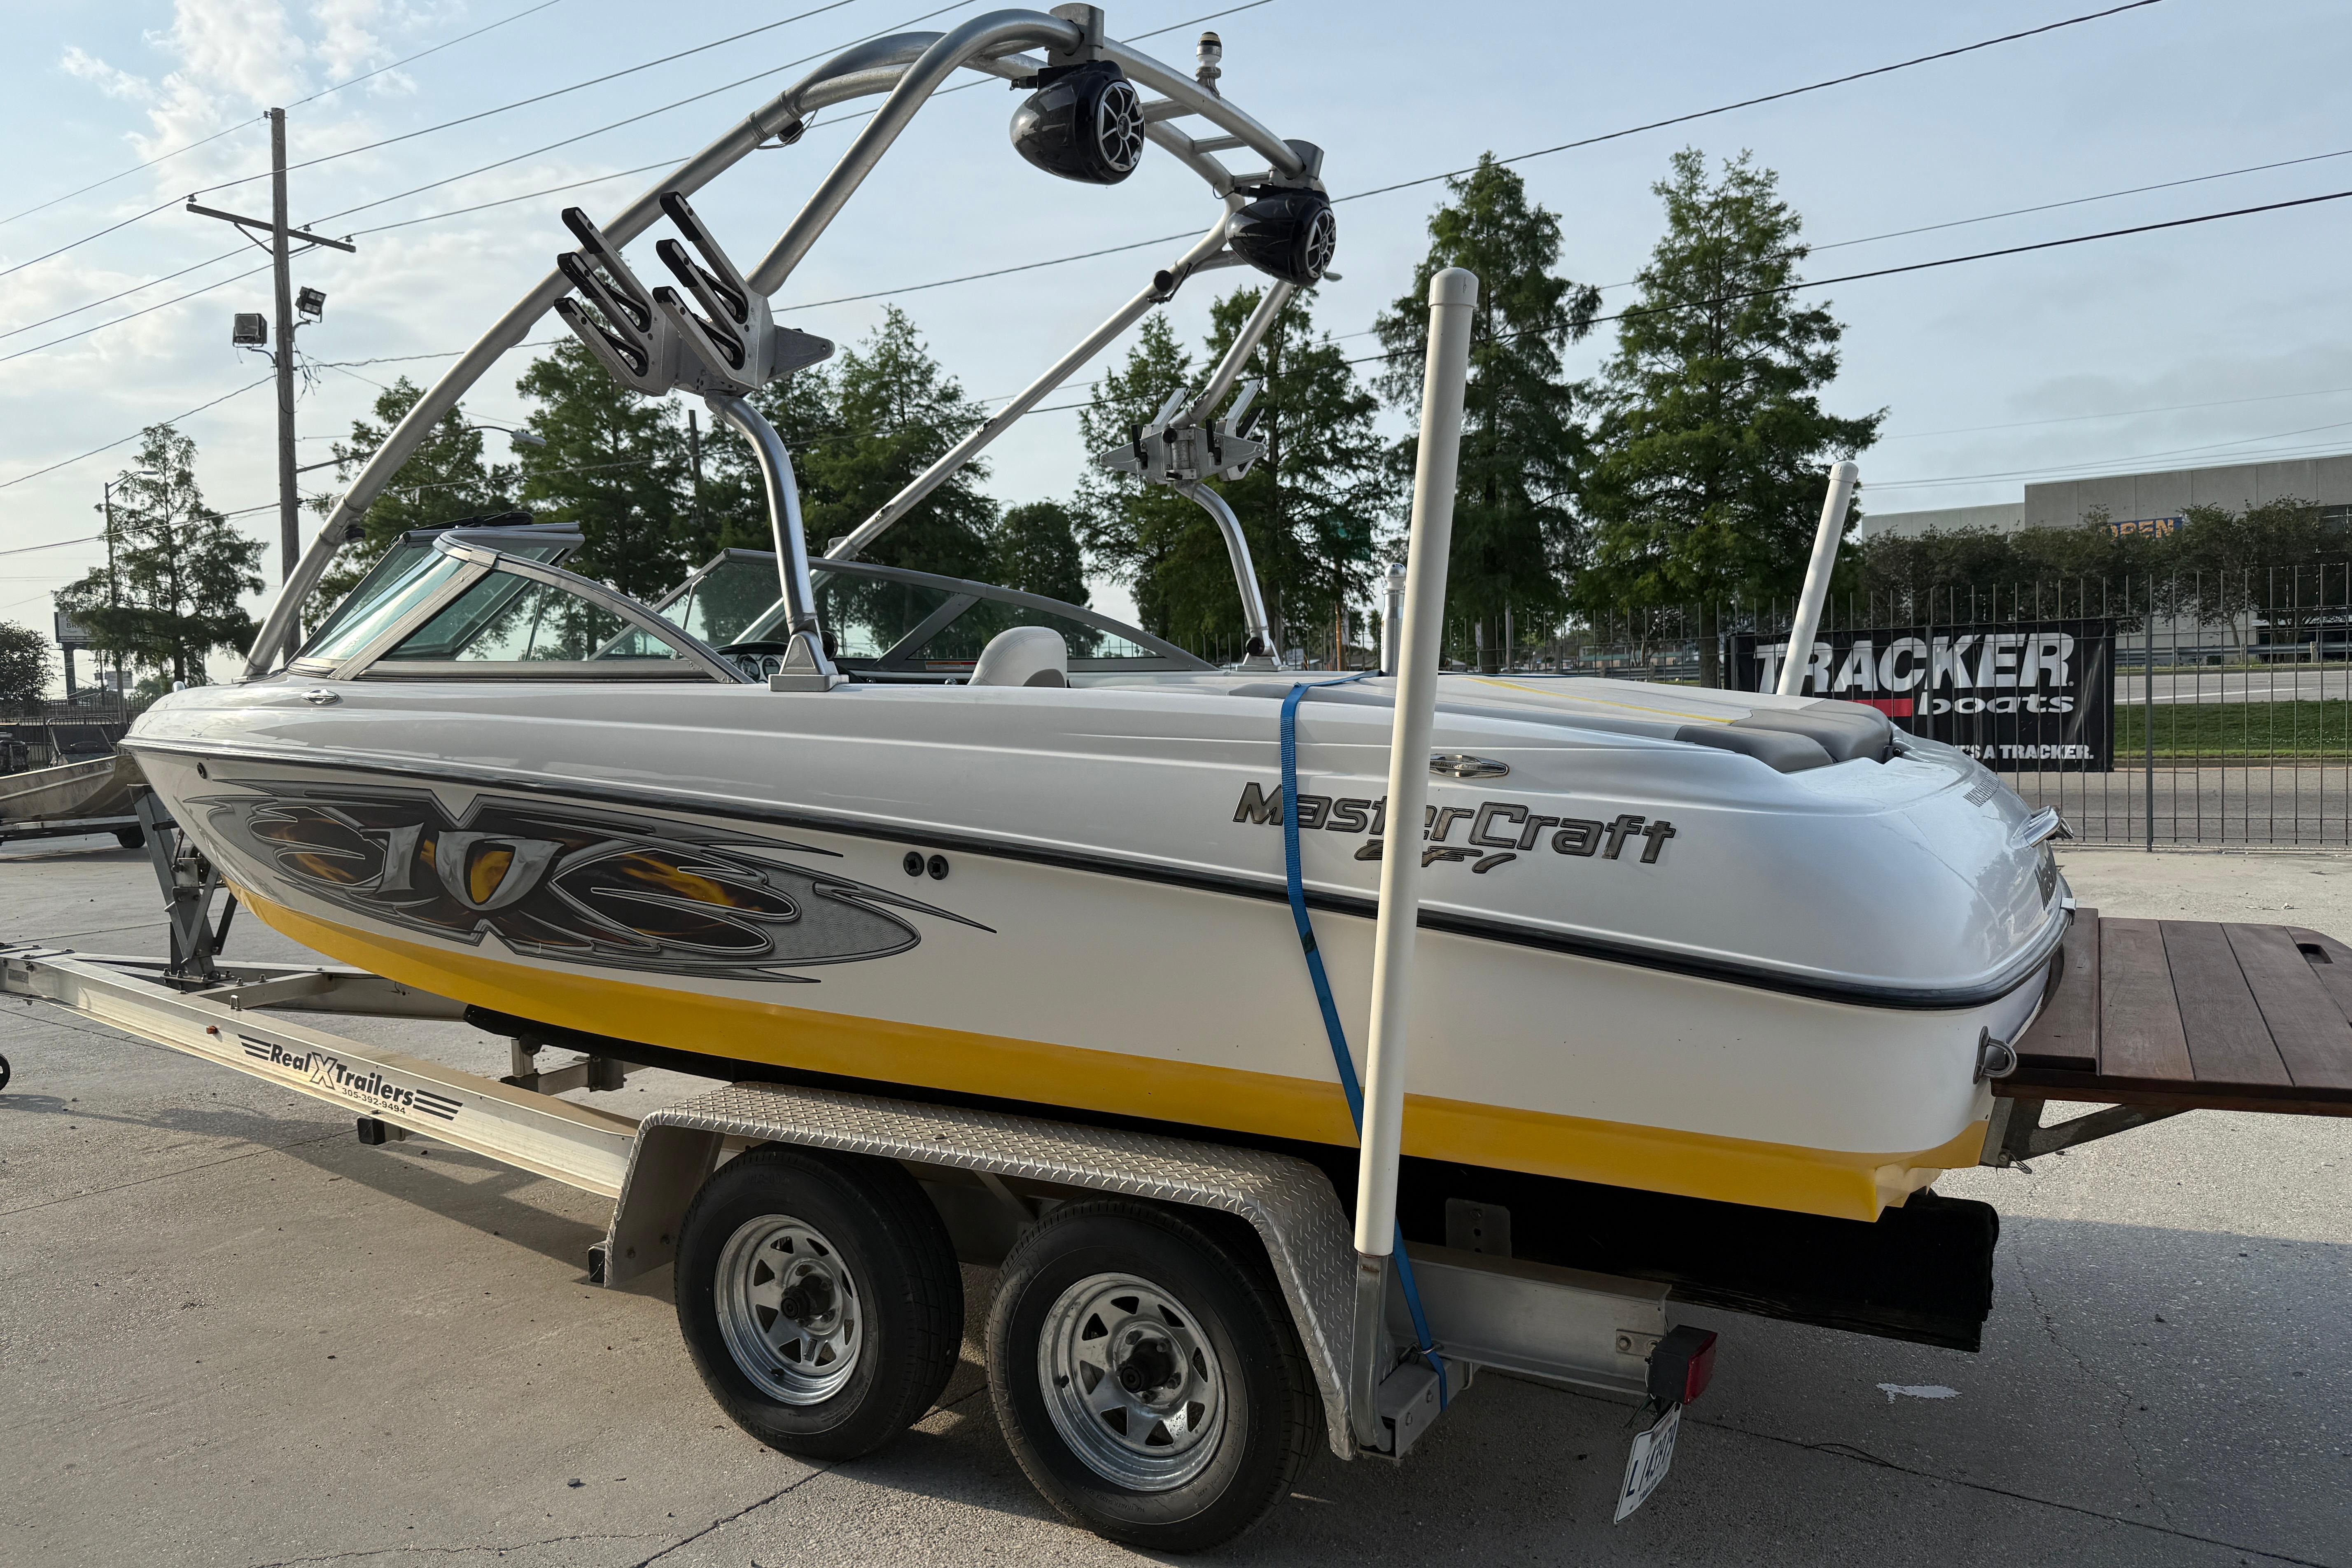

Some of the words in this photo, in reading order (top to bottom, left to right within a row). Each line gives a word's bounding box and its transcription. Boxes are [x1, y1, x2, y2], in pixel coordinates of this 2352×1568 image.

[1753, 633, 2074, 693] TRACKER
[1918, 693, 2074, 715] boats
[1983, 745, 1995, 759] A
[1999, 744, 2094, 759] TRACKER.
[1232, 782, 1676, 863] MastrCraft
[342, 1087, 406, 1114] 305-392-9494
